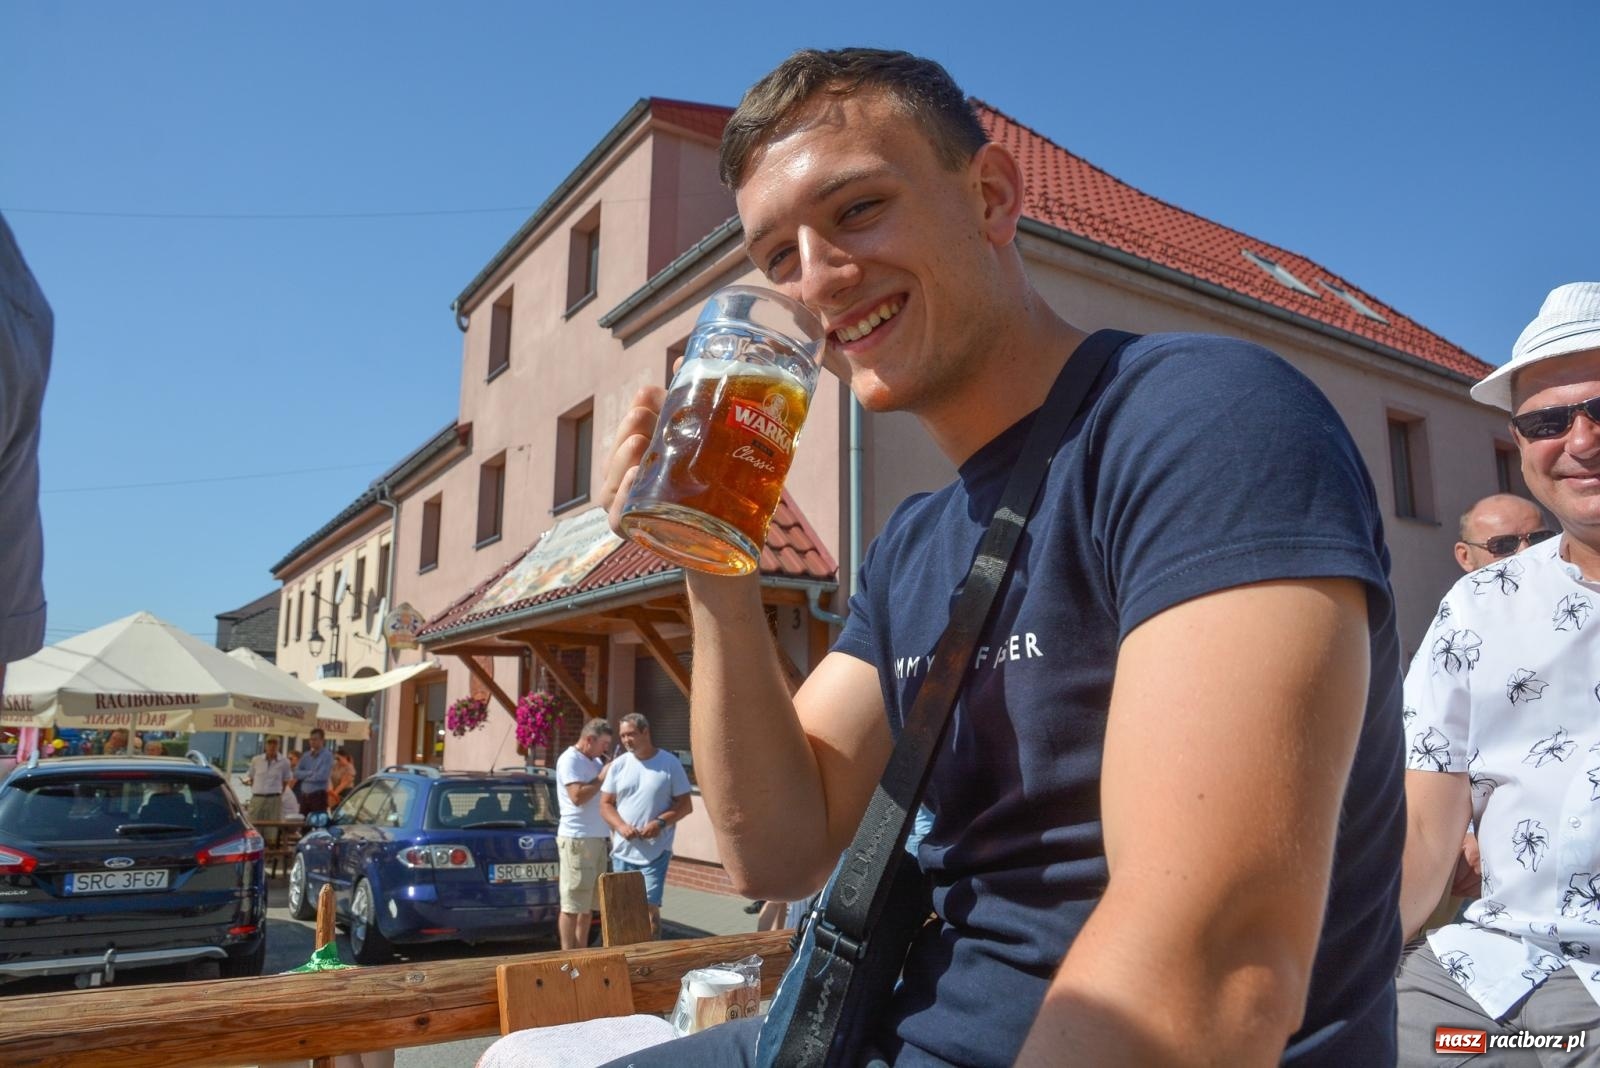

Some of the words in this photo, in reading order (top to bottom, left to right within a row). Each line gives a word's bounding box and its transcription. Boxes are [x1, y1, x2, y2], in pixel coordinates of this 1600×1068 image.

[735, 405, 792, 455] WARKA
[732, 446, 776, 472] Classic
[77, 873, 116, 890] SRC
[122, 871, 165, 888] 3FG7
[497, 865, 521, 879] SRC
